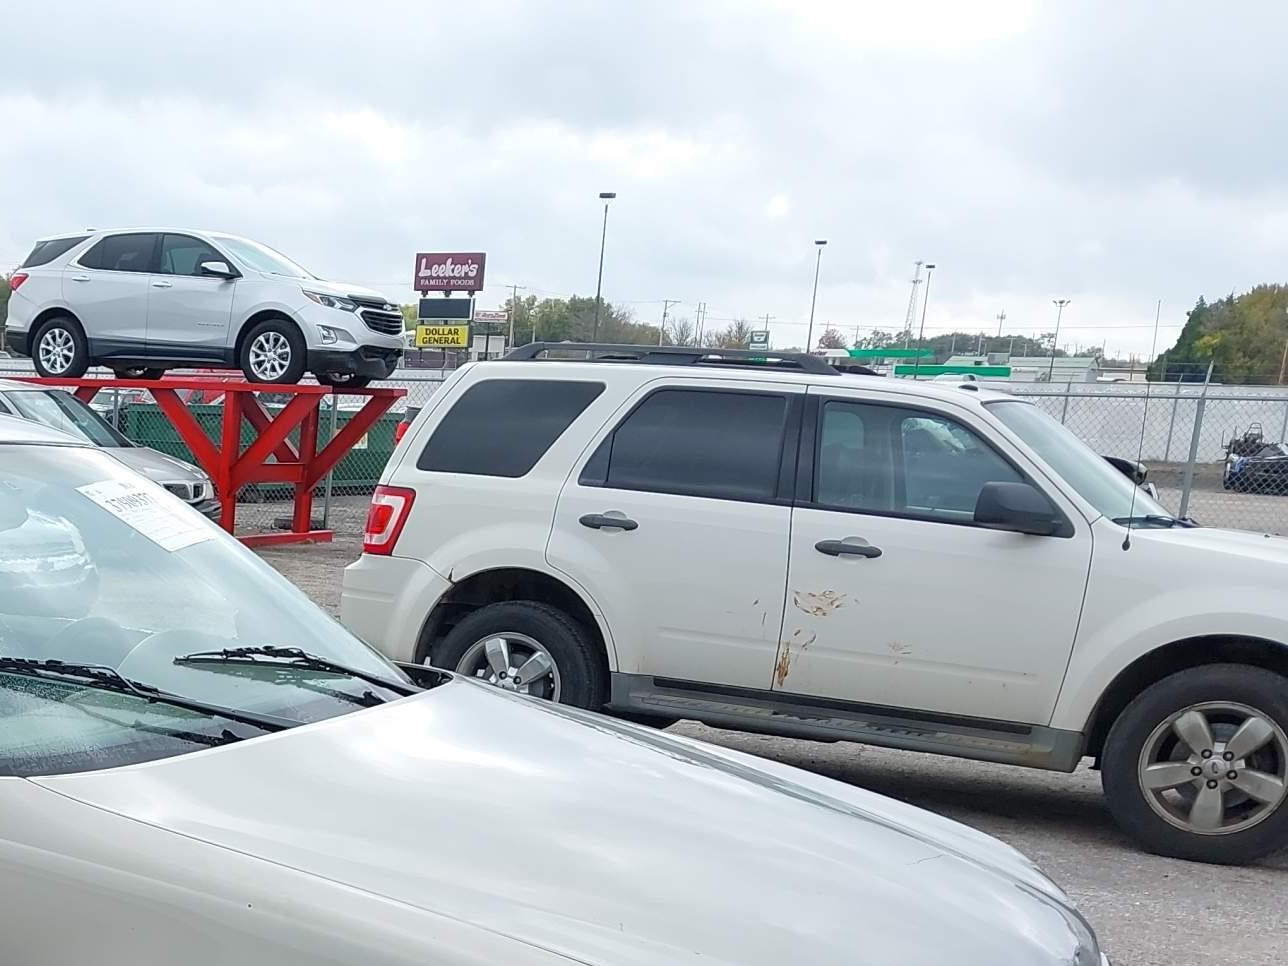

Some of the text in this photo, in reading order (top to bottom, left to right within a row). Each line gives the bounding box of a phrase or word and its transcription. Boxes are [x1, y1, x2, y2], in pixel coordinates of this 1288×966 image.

[418, 257, 479, 277] Leeker's
[424, 327, 460, 336] DOLLAR
[421, 337, 462, 345] GENERAL
